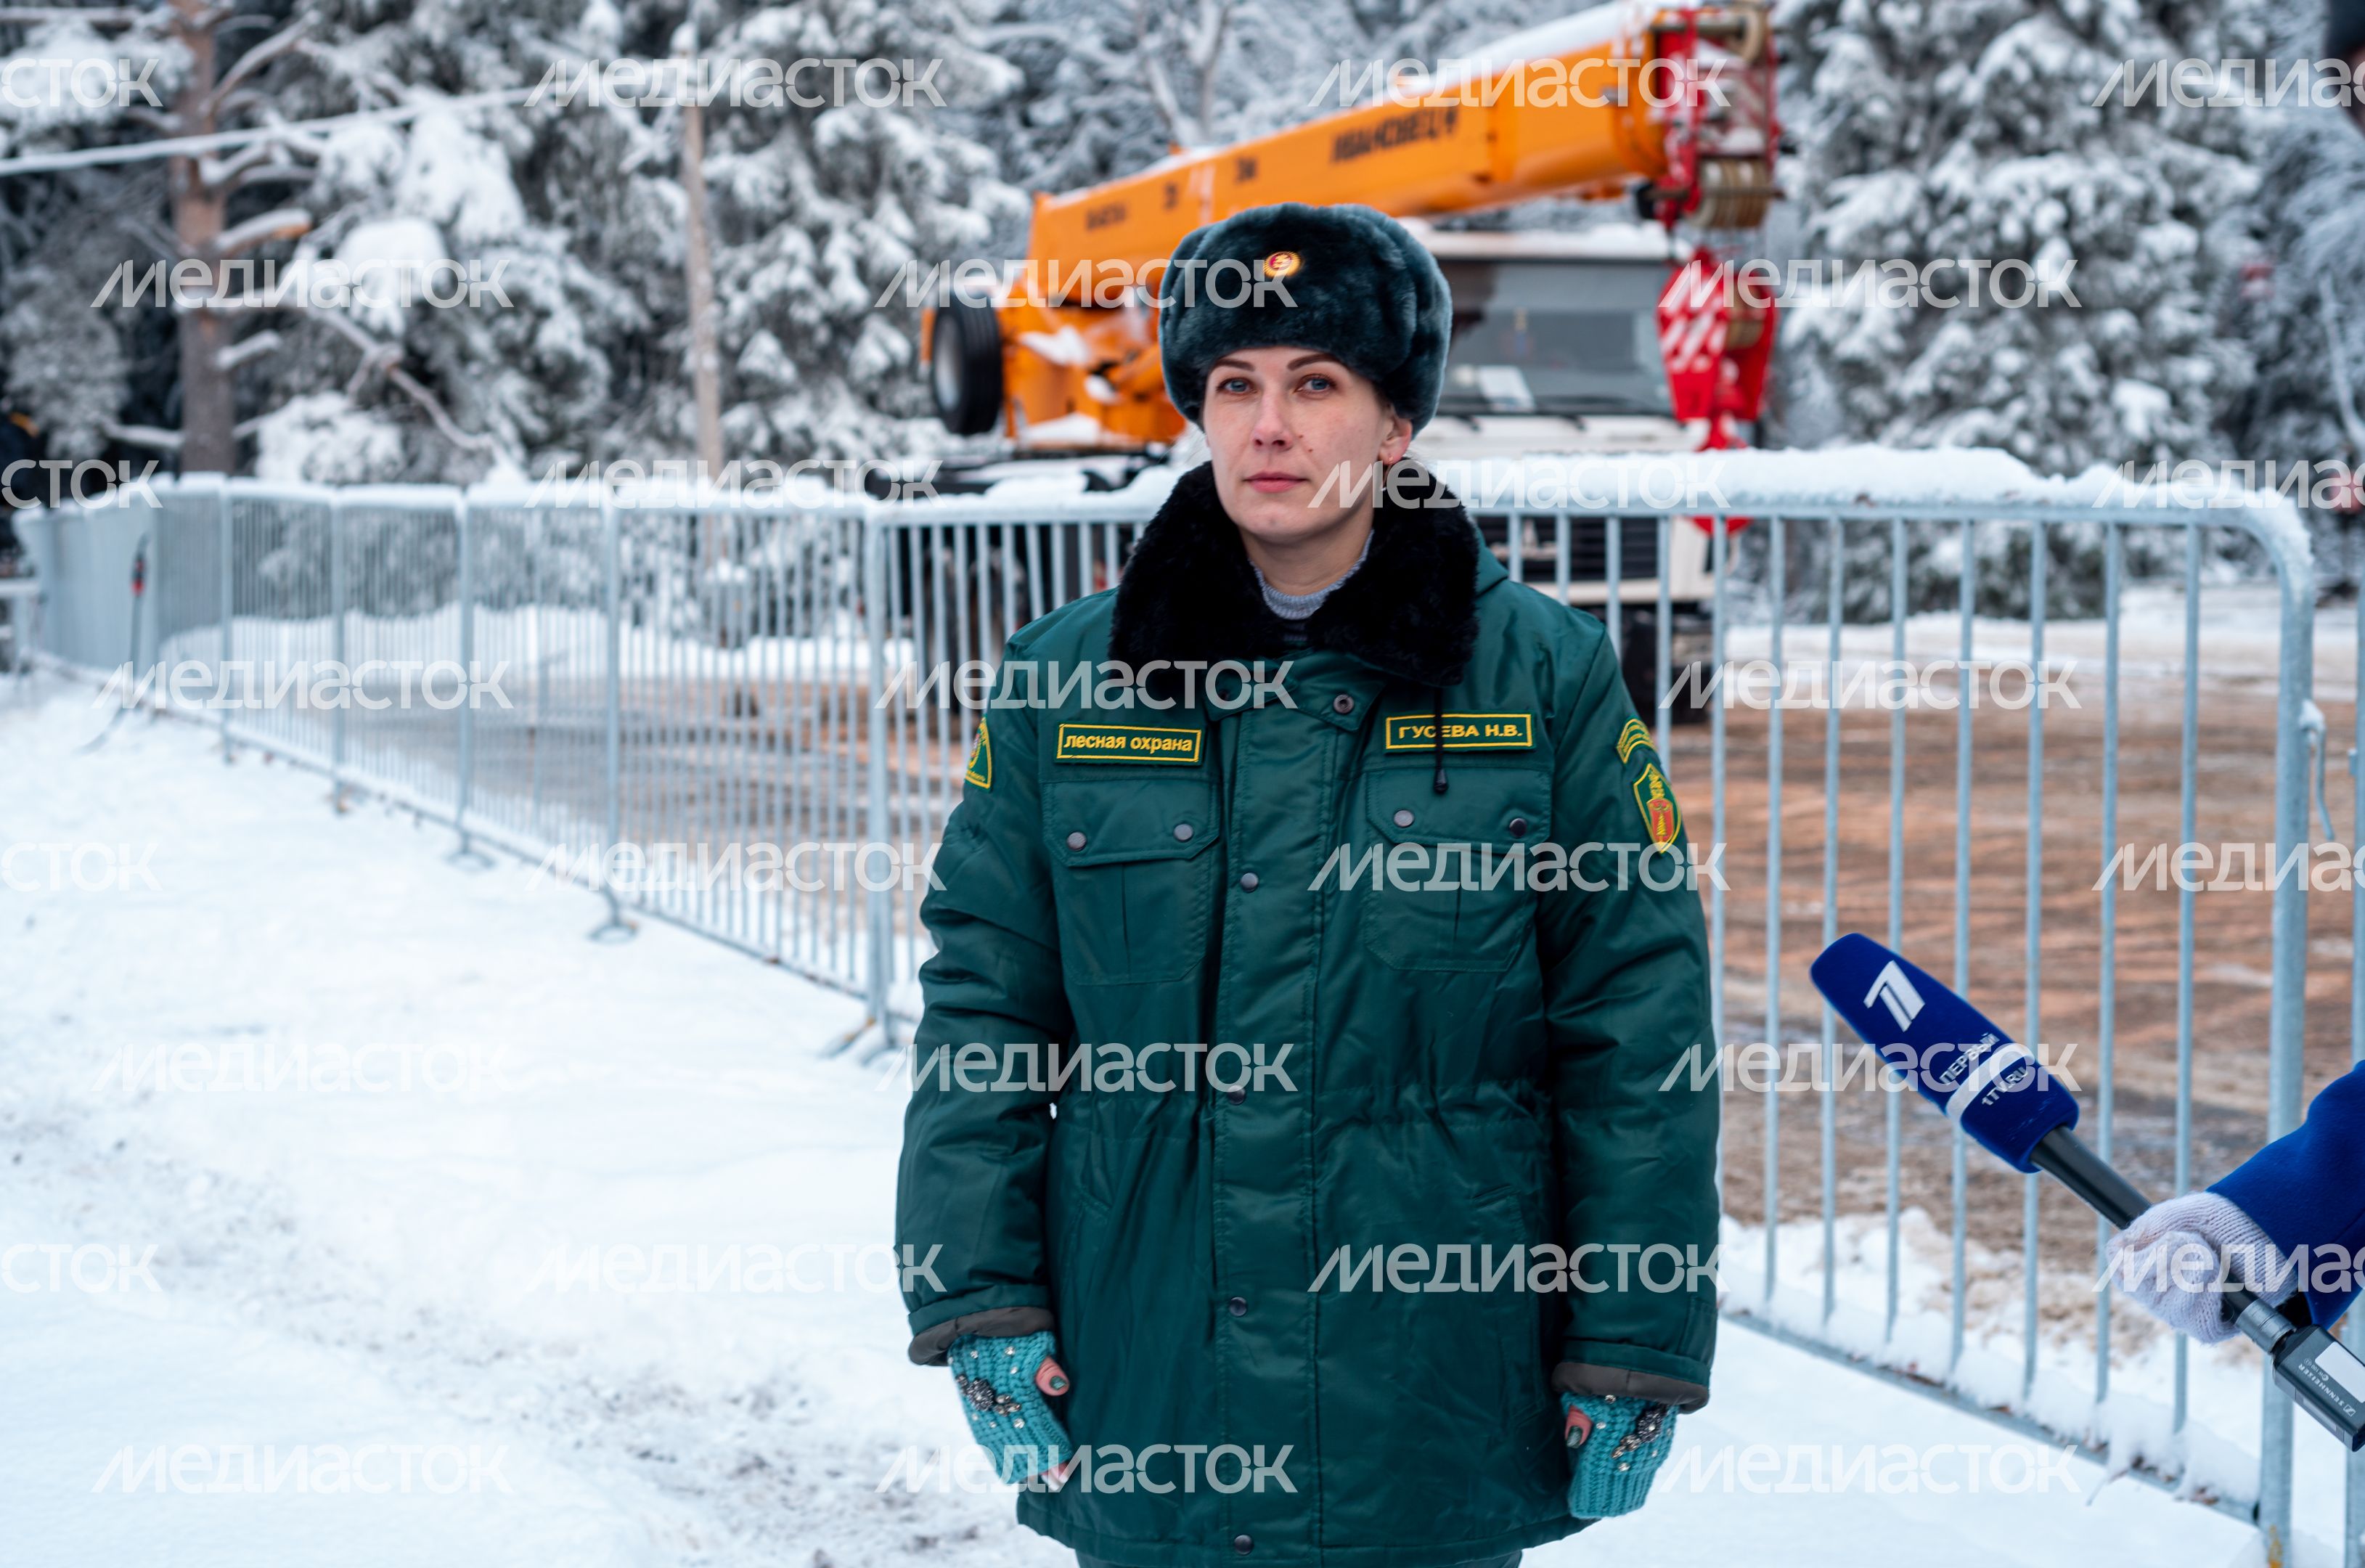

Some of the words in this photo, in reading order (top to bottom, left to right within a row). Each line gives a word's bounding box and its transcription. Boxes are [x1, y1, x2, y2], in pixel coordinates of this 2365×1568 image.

[1063, 734, 1127, 748] лесная
[1130, 735, 1193, 754] охрана
[1398, 724, 1479, 739] ГУСЕВА
[1485, 723, 1524, 737] Н.В.
[1939, 1032, 2001, 1086] ПЕРВЫЙ
[1981, 1066, 2028, 1106] 1TV.RU
[2298, 1363, 2345, 1406] SENNHEISER
